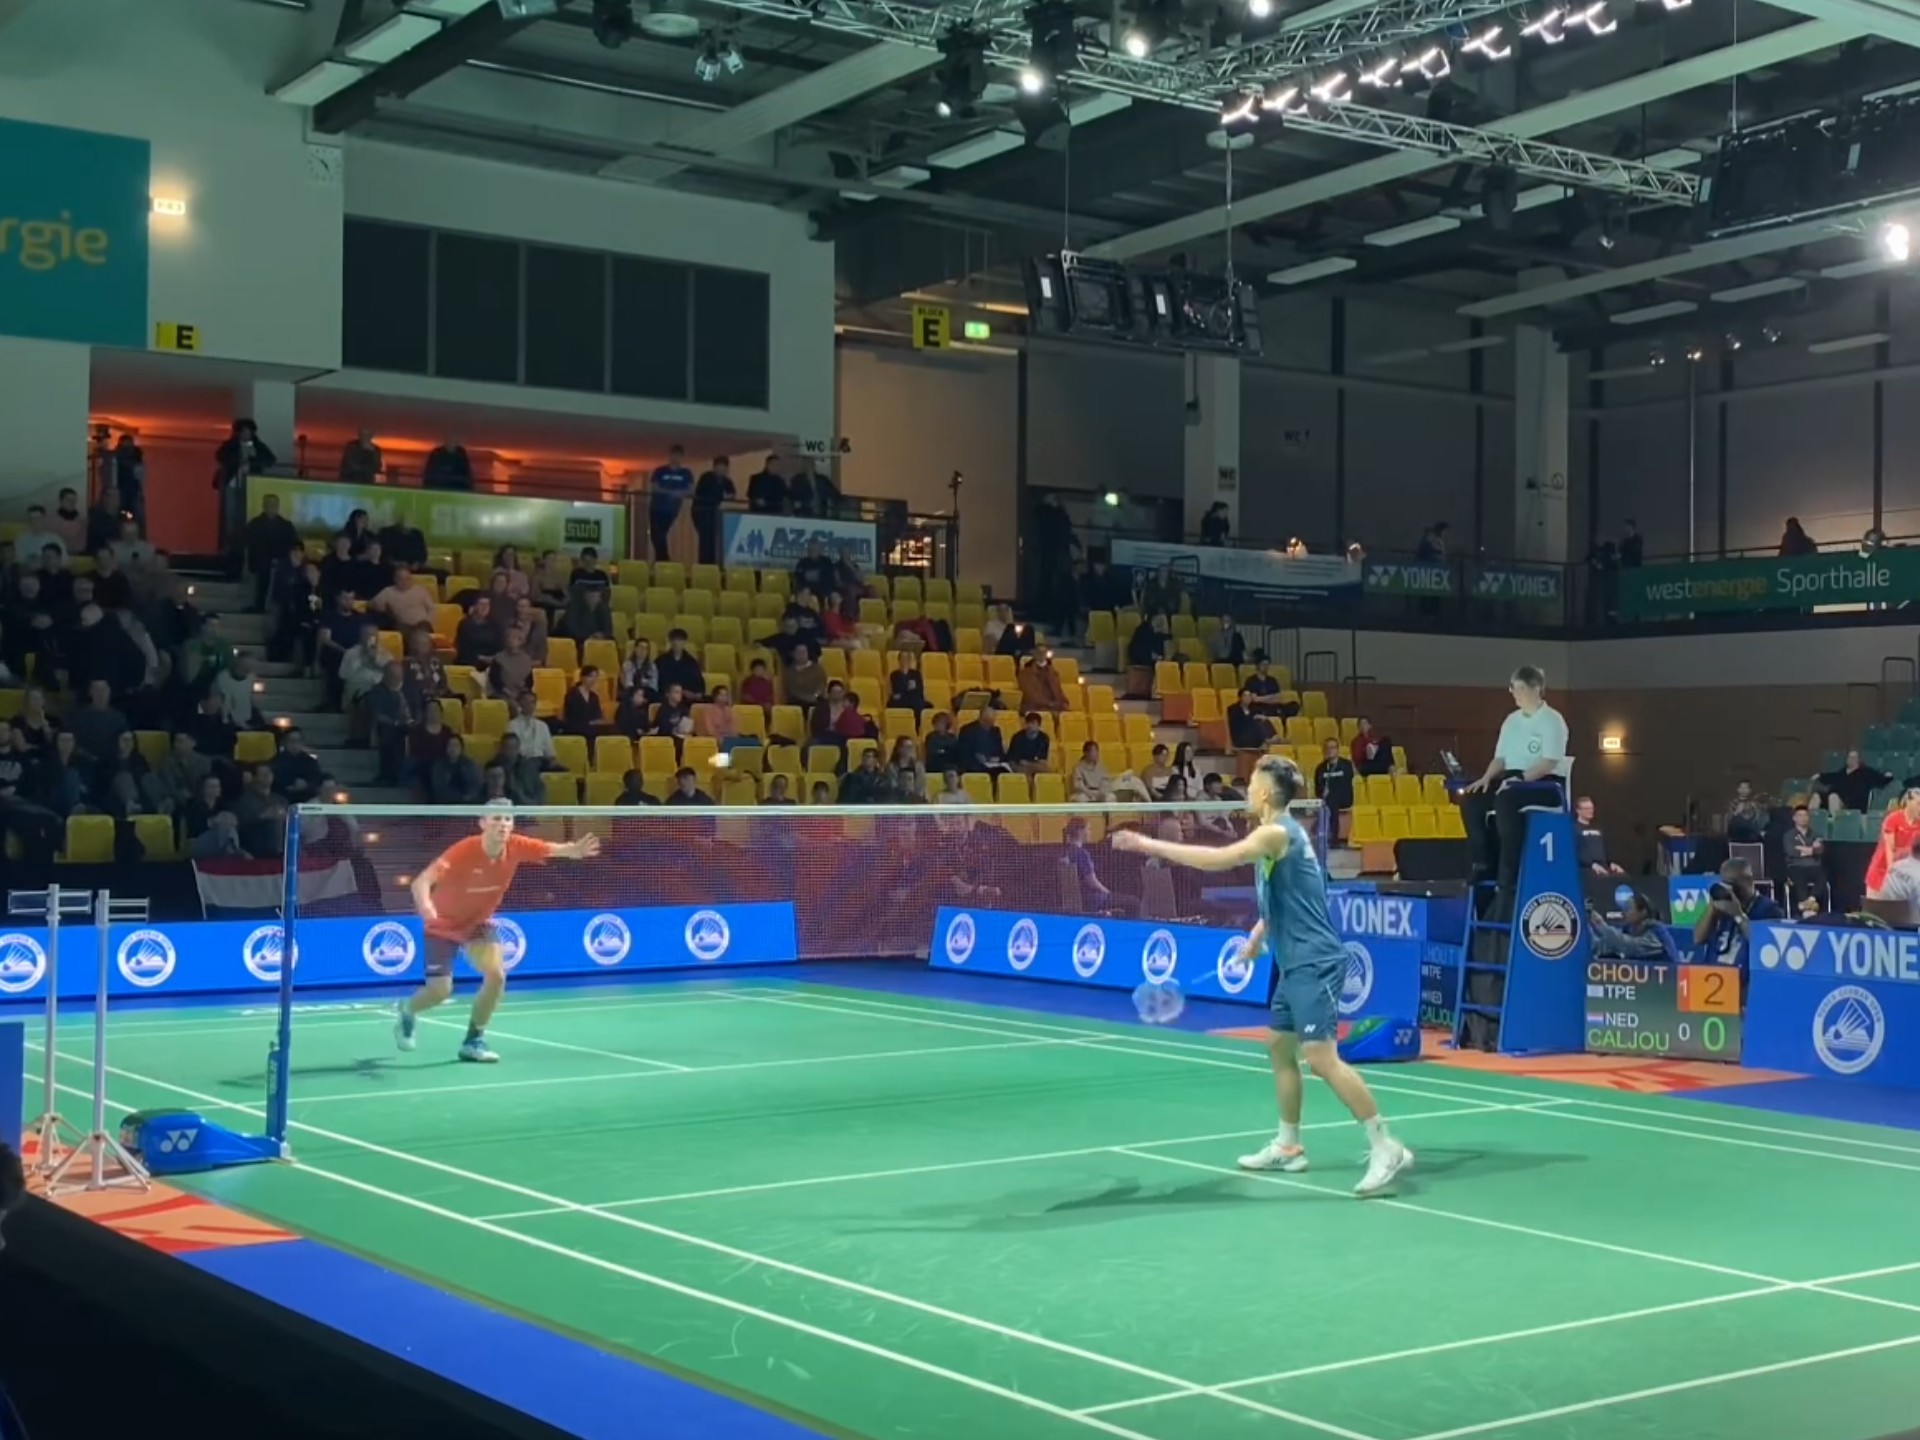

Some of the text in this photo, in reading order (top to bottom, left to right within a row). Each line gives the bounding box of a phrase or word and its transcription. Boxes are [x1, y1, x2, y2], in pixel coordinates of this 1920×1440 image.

[176, 324, 194, 350] E
[923, 318, 940, 348] E
[805, 440, 825, 452] WC
[1400, 566, 1450, 590] YONEX
[1509, 574, 1556, 597] YONEX
[1646, 562, 1890, 601] westenergie Sporthalle
[1540, 832, 1553, 861] 1
[1338, 898, 1413, 937] YONEX
[1587, 962, 1668, 984] CHOU T
[1605, 985, 1636, 1000] TPE
[1679, 979, 1688, 998] 1
[1703, 972, 1724, 1006] 2
[1605, 1012, 1639, 1028] NED
[1679, 1022, 1690, 1041] 0
[1587, 1028, 1670, 1051] CALJOU
[1703, 1017, 1725, 1051] 0
